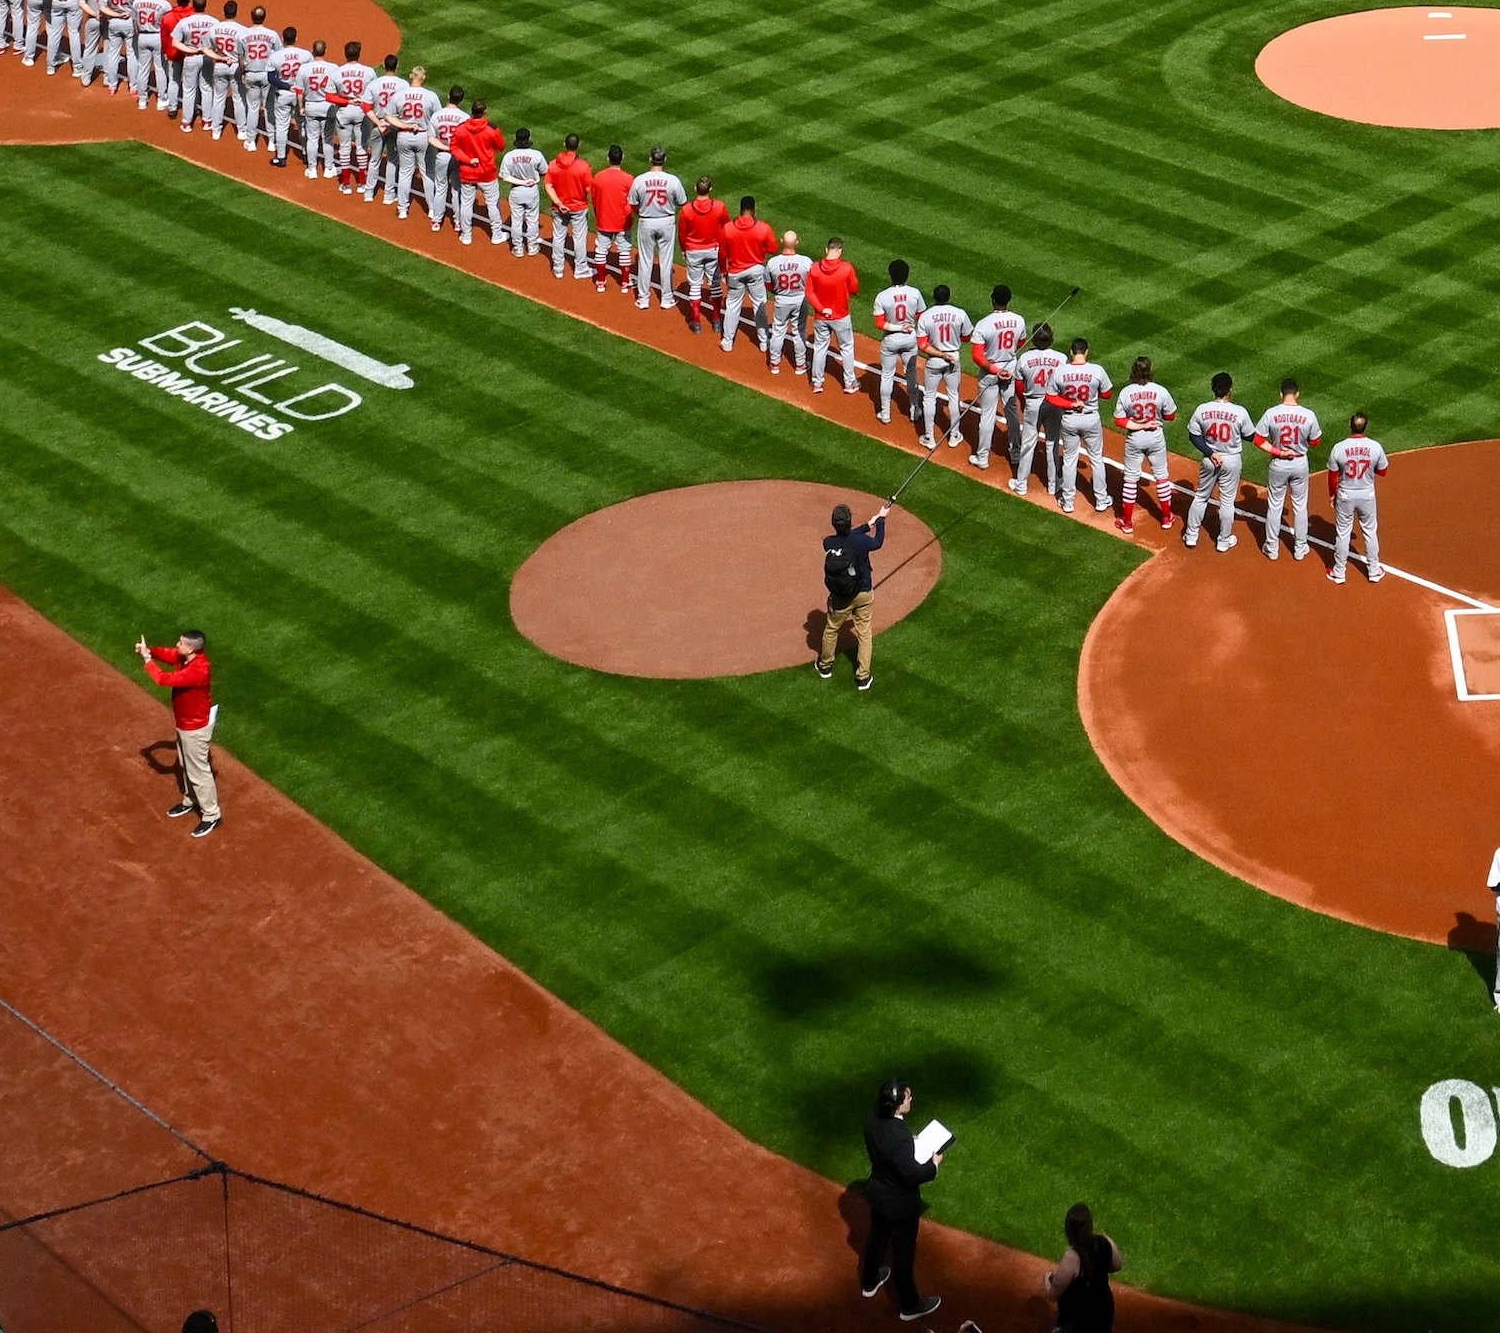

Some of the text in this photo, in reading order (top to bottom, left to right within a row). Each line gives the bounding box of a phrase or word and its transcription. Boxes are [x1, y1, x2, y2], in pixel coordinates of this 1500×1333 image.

[645, 189, 668, 206] 75
[777, 274, 800, 290] 82
[137, 320, 363, 421] BUILD
[97, 347, 294, 440] SUBMARINES
[1206, 423, 1231, 443] 40
[1279, 425, 1299, 445] 21
[1345, 459, 1371, 480] 37
